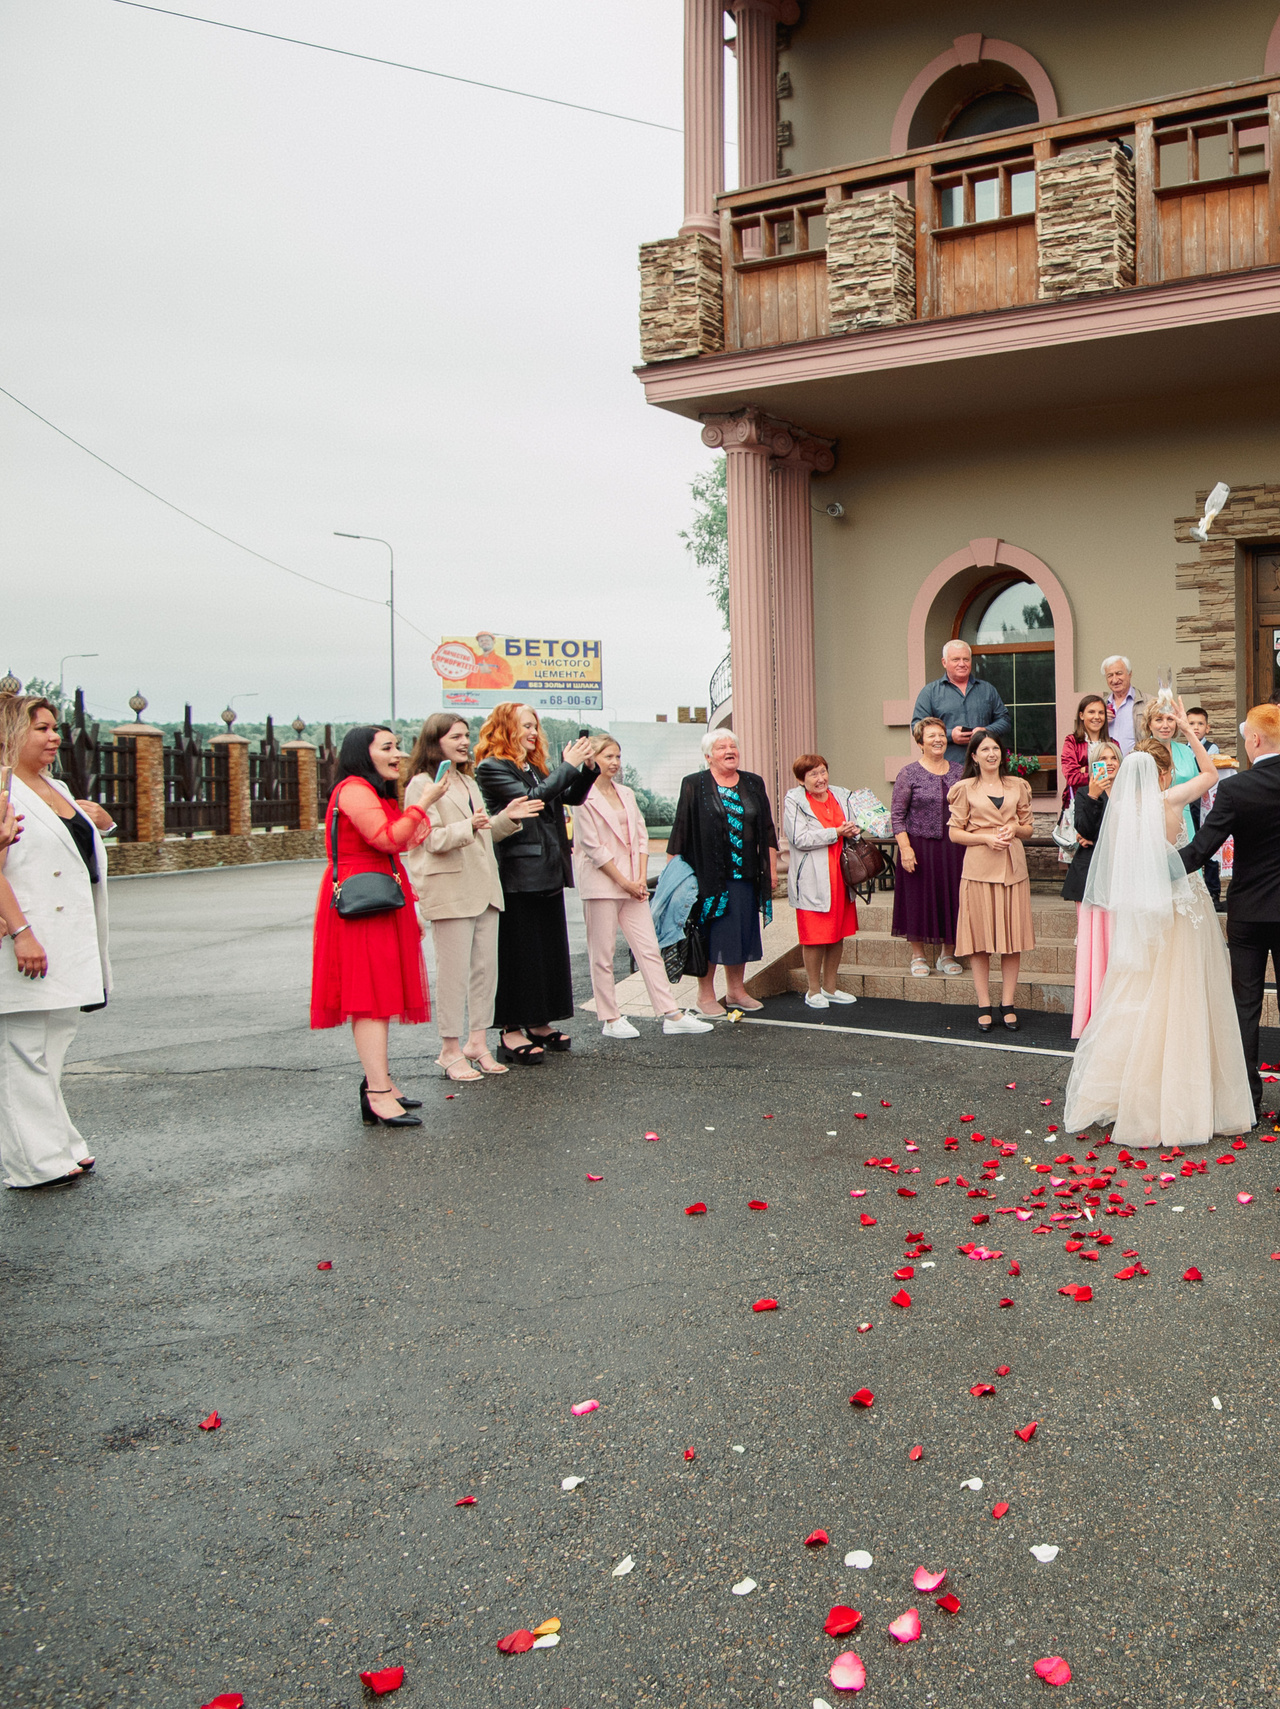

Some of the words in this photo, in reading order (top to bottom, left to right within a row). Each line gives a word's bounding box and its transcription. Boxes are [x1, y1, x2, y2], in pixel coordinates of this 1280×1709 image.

[505, 639, 599, 658] БЕТОН
[442, 649, 471, 662] КАЧЕСТВО
[540, 659, 590, 667] ЧИСТОГО
[534, 670, 586, 678] ЦЕМЕНТА
[550, 695, 598, 706] 68-00-67
